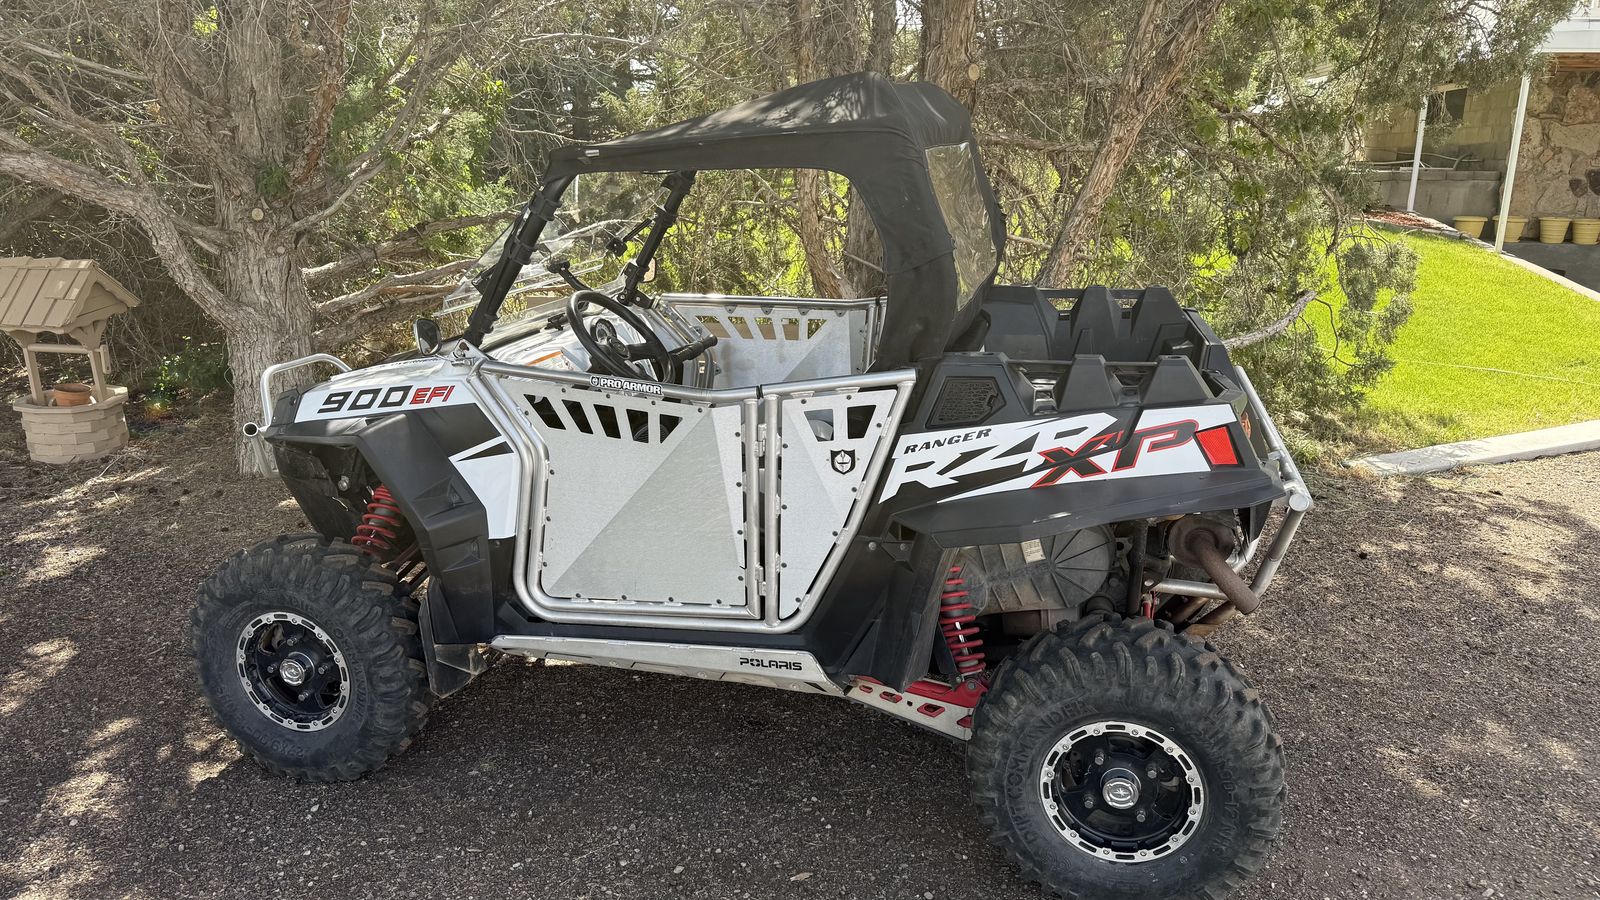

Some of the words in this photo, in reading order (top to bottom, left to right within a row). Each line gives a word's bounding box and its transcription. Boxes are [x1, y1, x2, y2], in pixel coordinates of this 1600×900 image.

[600, 377, 622, 389] PRO
[622, 380, 662, 395] ARMOR
[317, 385, 413, 414] 900
[410, 385, 455, 405] EFI
[904, 428, 992, 454] RANGER
[878, 412, 1119, 504] RZR
[1030, 418, 1200, 489] XP
[739, 657, 802, 671] POLARIS
